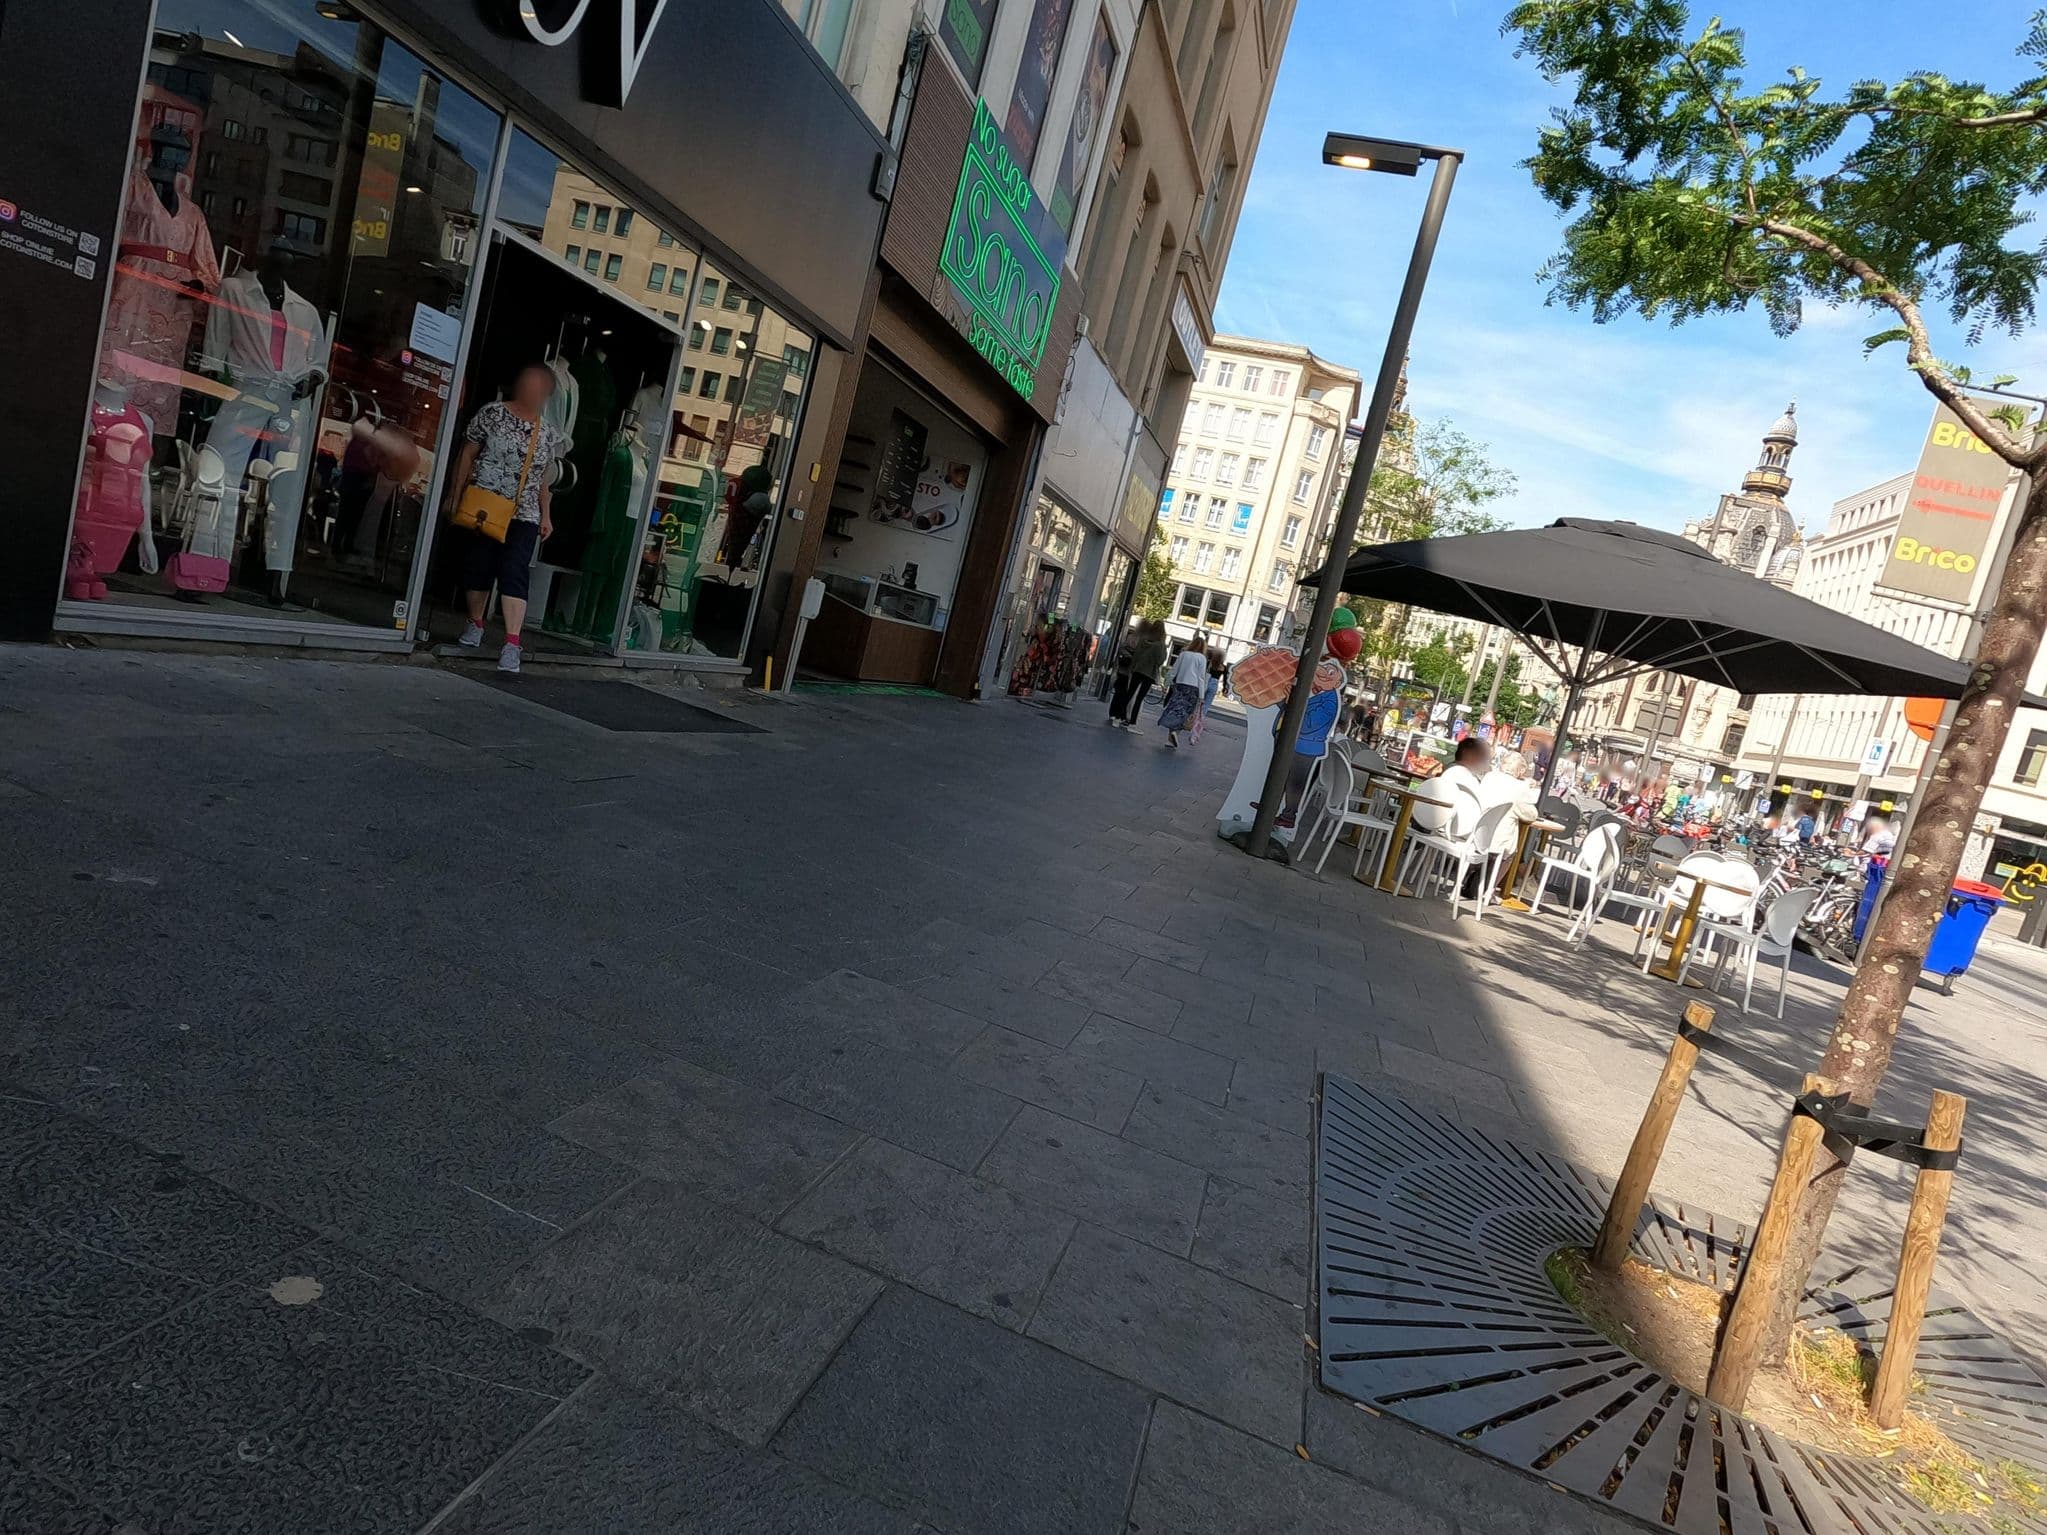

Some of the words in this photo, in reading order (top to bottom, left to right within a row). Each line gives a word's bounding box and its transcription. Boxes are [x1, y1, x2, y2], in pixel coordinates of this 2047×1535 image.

[973, 95, 996, 155] No
[996, 145, 1032, 212] sugar
[1, 230, 24, 243] SHOP
[25, 240, 54, 255] ONLINE
[20, 210, 53, 228] FOLLOW
[53, 223, 65, 233] US
[65, 228, 78, 238] ON
[957, 180, 1043, 350] Sano
[969, 311, 1006, 371] Same
[1006, 352, 1034, 400] taste
[1894, 536, 1976, 574] Brico
